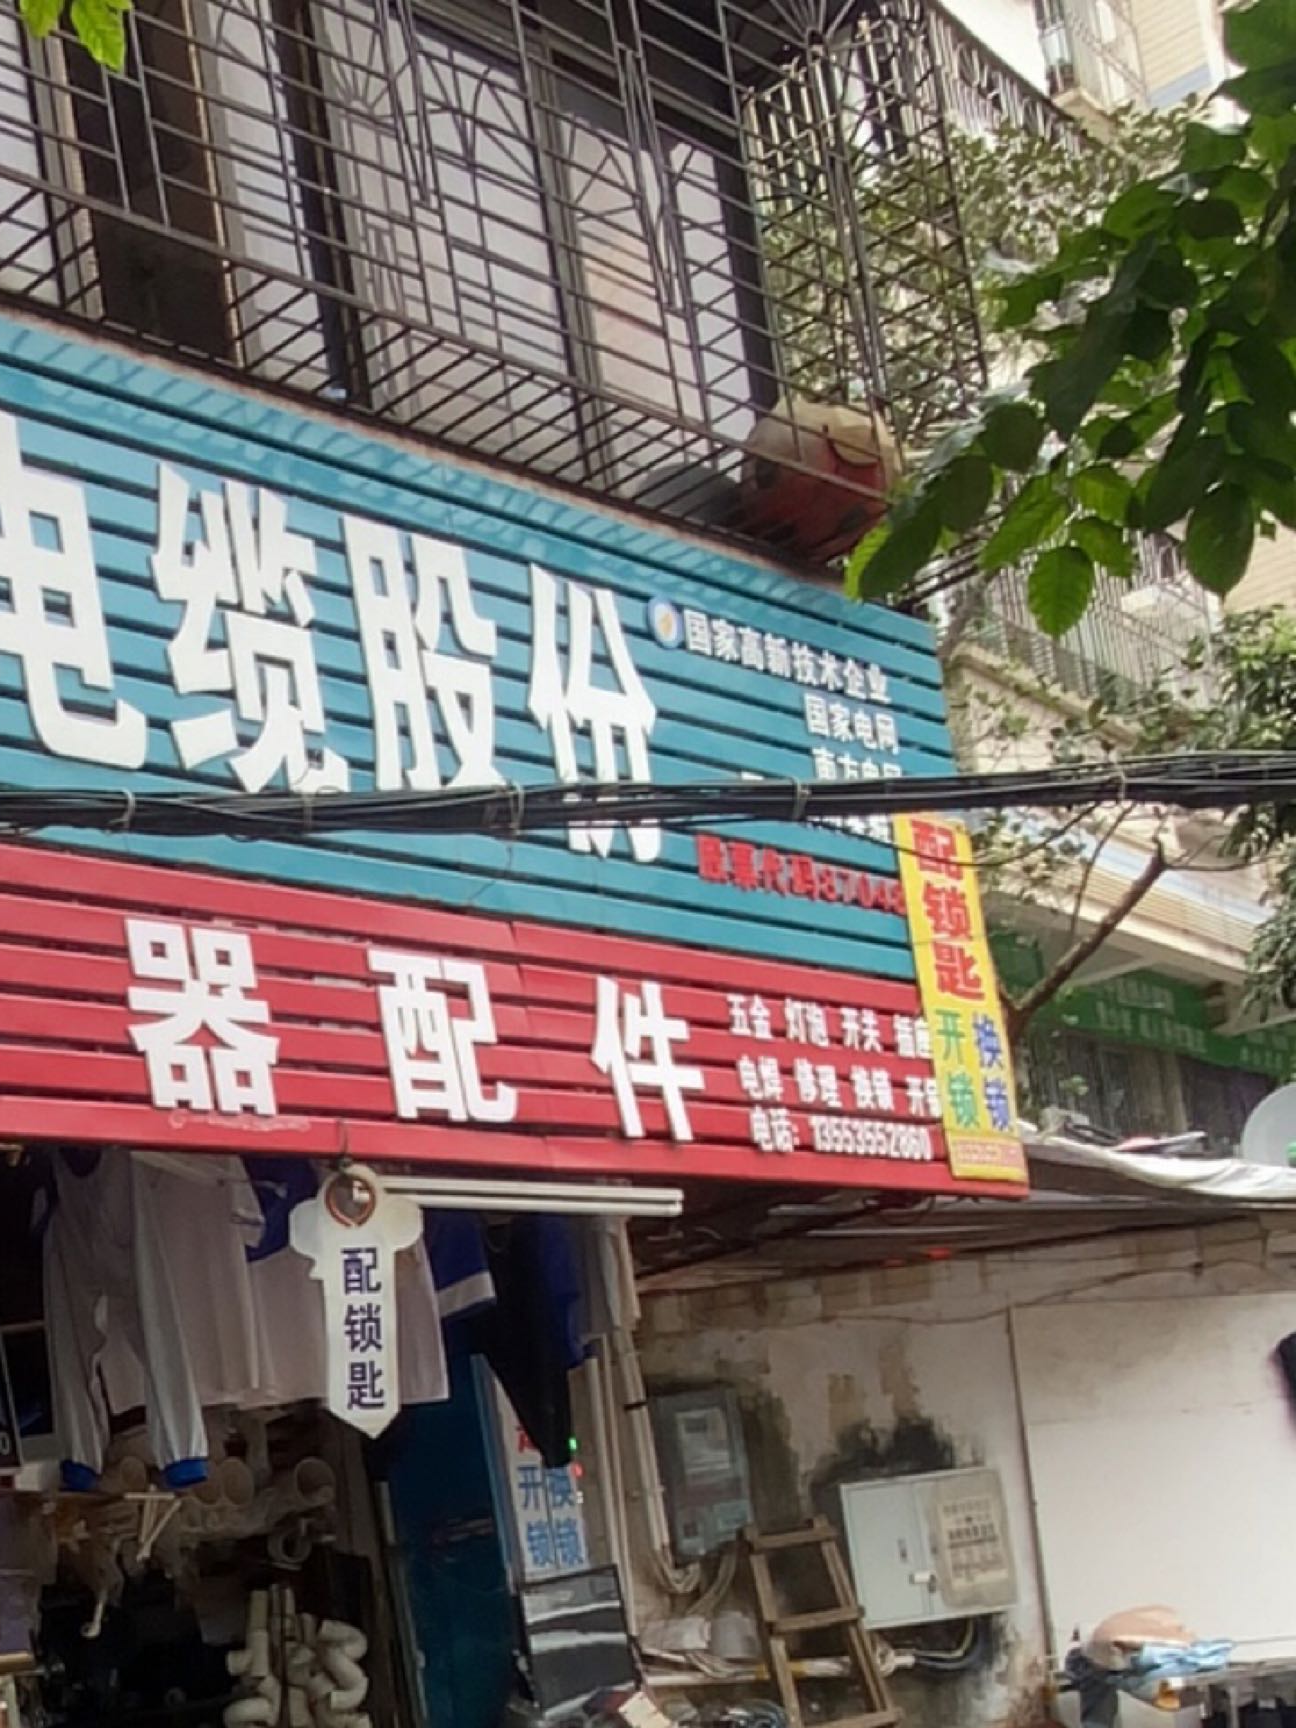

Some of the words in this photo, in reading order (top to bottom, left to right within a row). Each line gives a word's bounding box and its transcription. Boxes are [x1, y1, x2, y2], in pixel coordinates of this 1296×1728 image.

[683, 608, 892, 704] 国家高新技术企业
[804, 692, 900, 755] 国家电网
[911, 818, 985, 1002] 配锁匙
[726, 992, 773, 1040] 五金
[784, 997, 829, 1047] 灯泡
[839, 1006, 883, 1053] 开关
[793, 1057, 843, 1108] 修理
[934, 1008, 980, 1130] 开锁
[808, 1115, 934, 1161] 13553552860
[340, 1247, 386, 1411] 配锁匙
